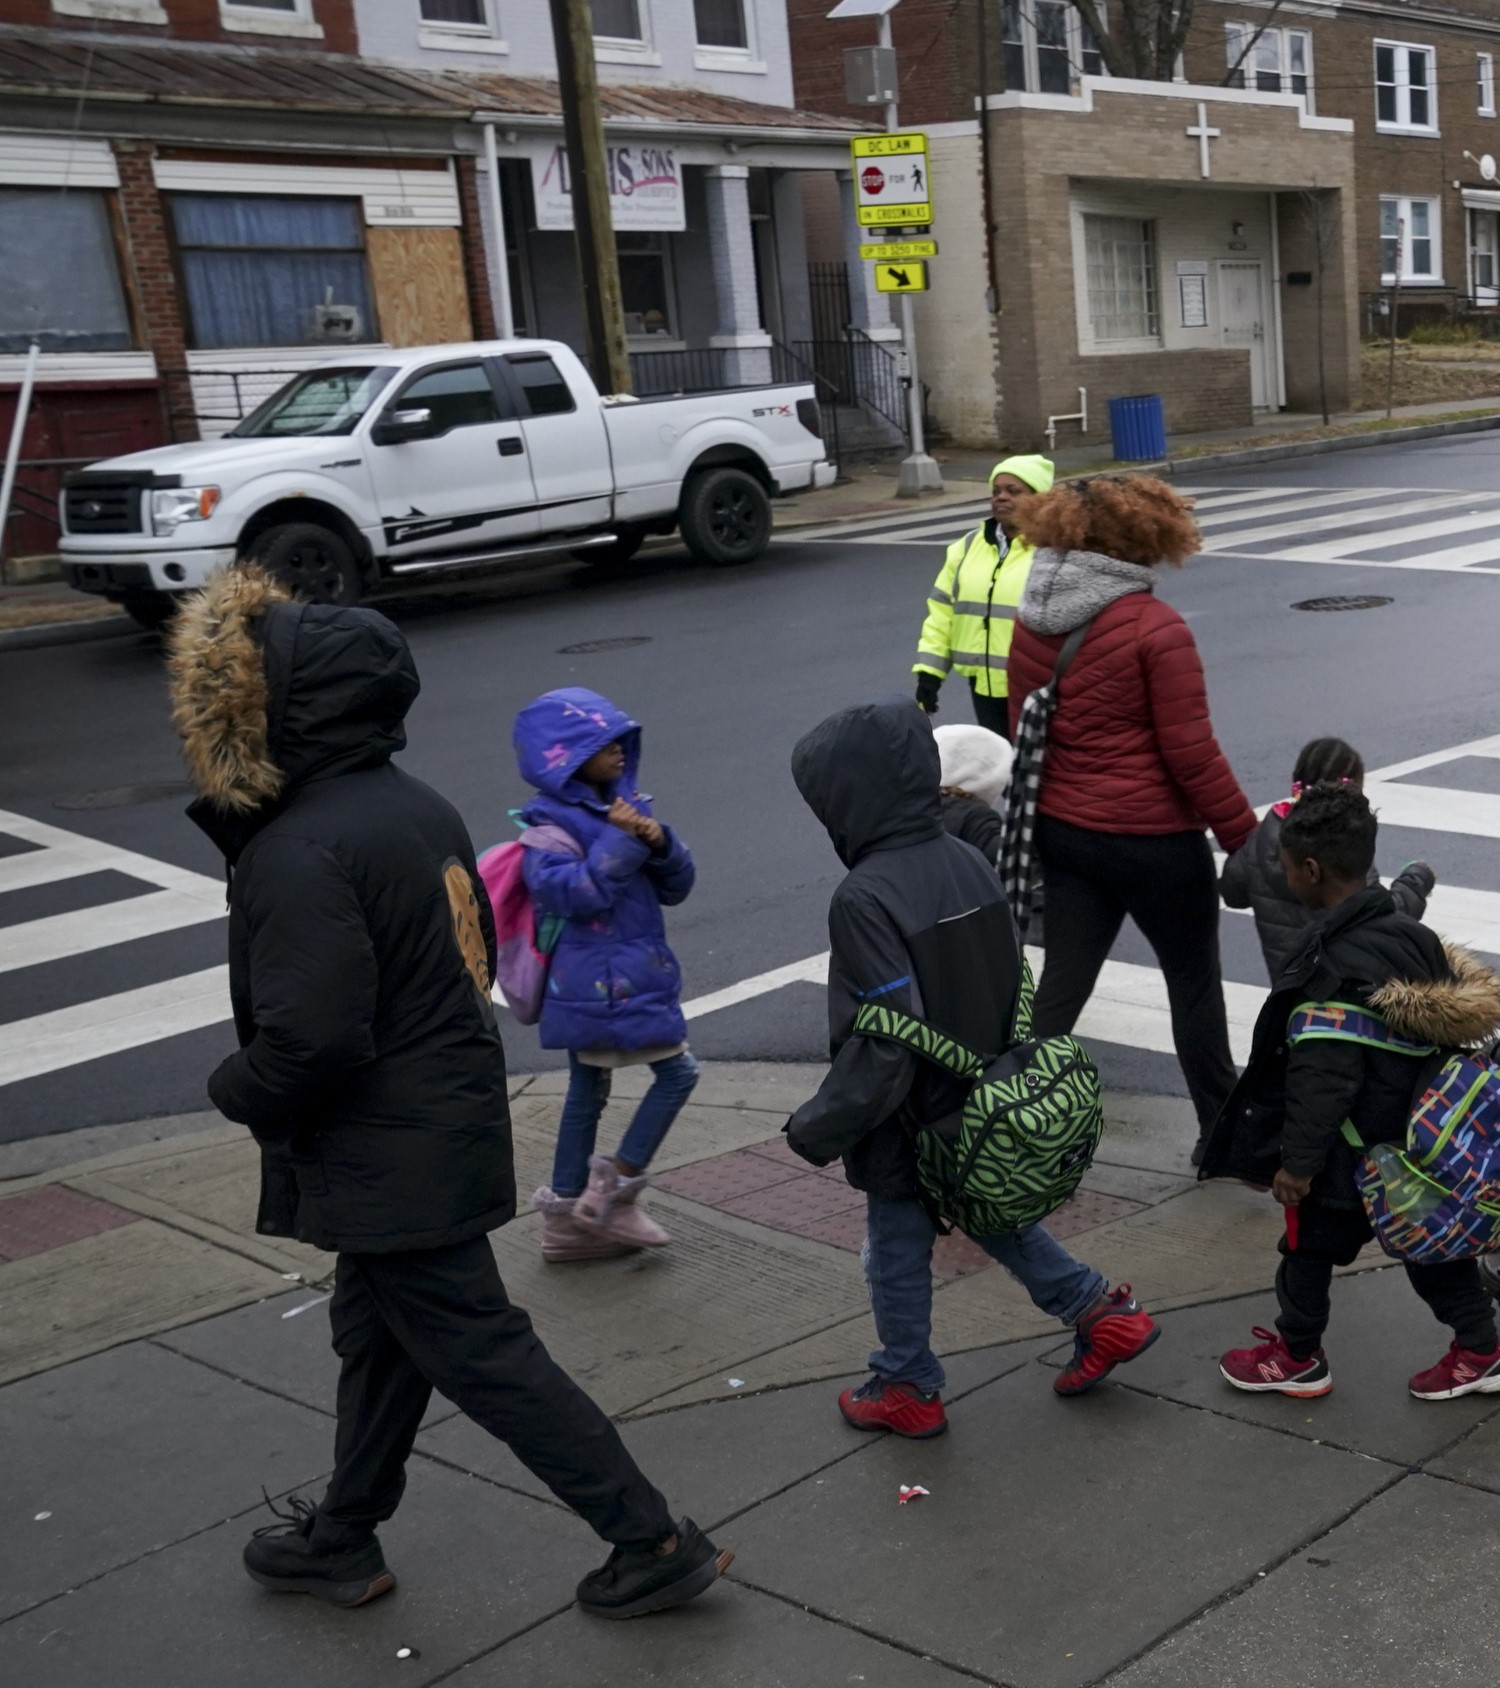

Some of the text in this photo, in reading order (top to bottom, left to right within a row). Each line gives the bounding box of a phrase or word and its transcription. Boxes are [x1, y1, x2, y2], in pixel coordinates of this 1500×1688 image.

[868, 139, 911, 153] DC LAW
[861, 174, 906, 187] STOP FOR
[877, 206, 927, 220] CROSSWALKS
[752, 404, 791, 418] STX
